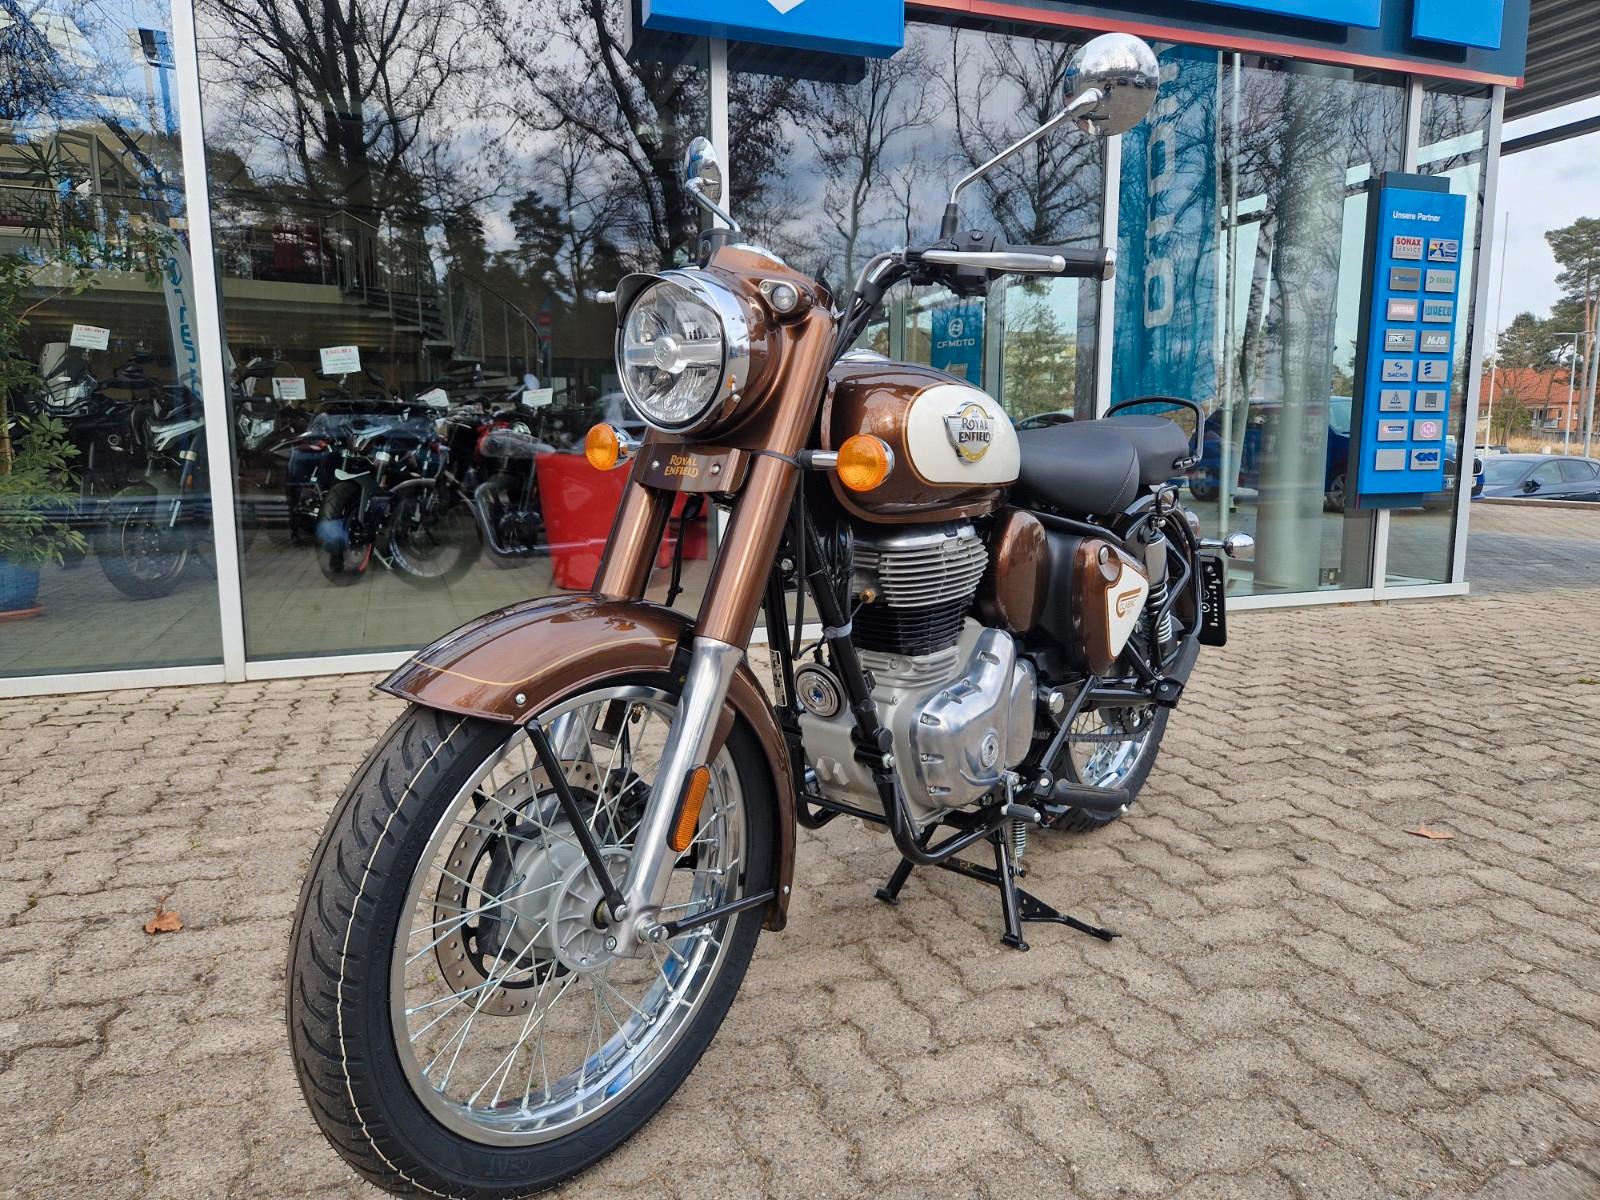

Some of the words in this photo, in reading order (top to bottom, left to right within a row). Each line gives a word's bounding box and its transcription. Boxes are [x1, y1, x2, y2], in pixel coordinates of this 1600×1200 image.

[1393, 210, 1416, 220] Unsere
[1417, 213, 1441, 222] Partner
[1396, 238, 1421, 246] SONAX
[936, 338, 975, 349] CFMOTO
[961, 417, 988, 430] ROYAL
[958, 431, 991, 444] ENFIELD
[669, 454, 698, 465] ROYAL
[663, 465, 699, 478] ENFIELD
